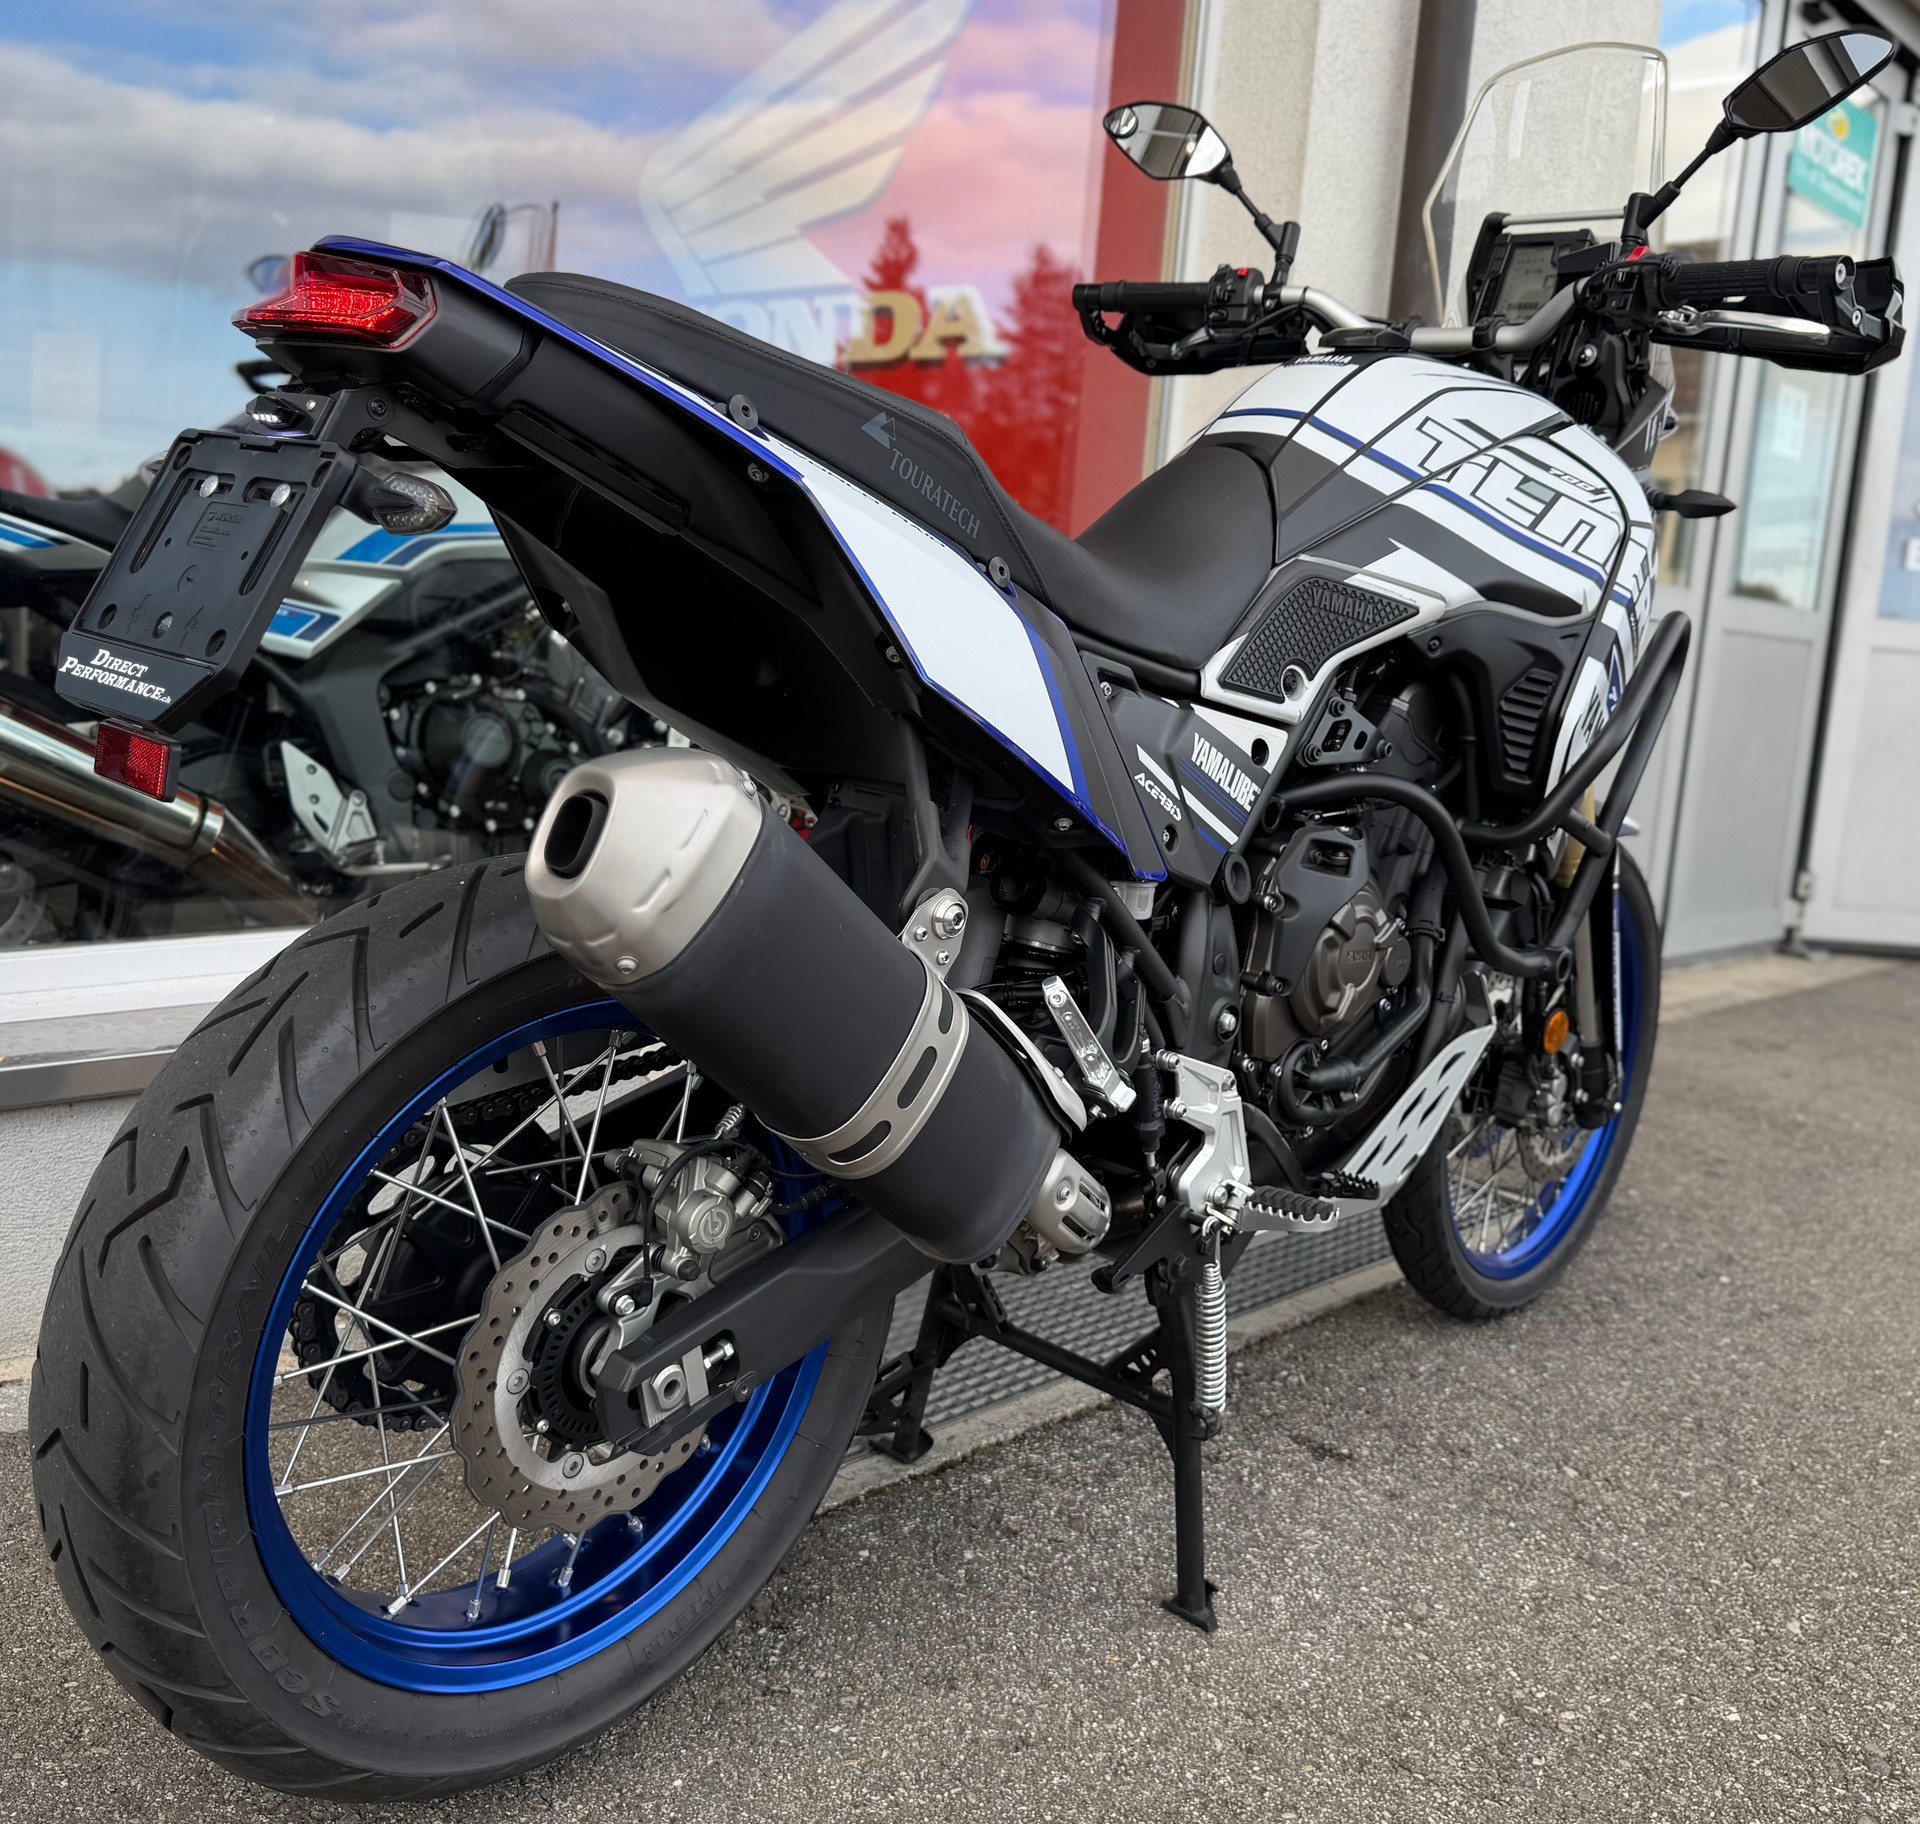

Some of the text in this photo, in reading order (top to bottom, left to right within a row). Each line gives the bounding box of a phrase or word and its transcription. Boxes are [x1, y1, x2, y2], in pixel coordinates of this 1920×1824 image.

[889, 448, 981, 539] TOURATECH
[1309, 584, 1376, 624] YAMAHA
[90, 648, 149, 678] DIRECT
[1134, 772, 1182, 821] ACERBIS
[207, 1222, 292, 1428] TRAIL
[202, 1453, 341, 1718] SCORPION
